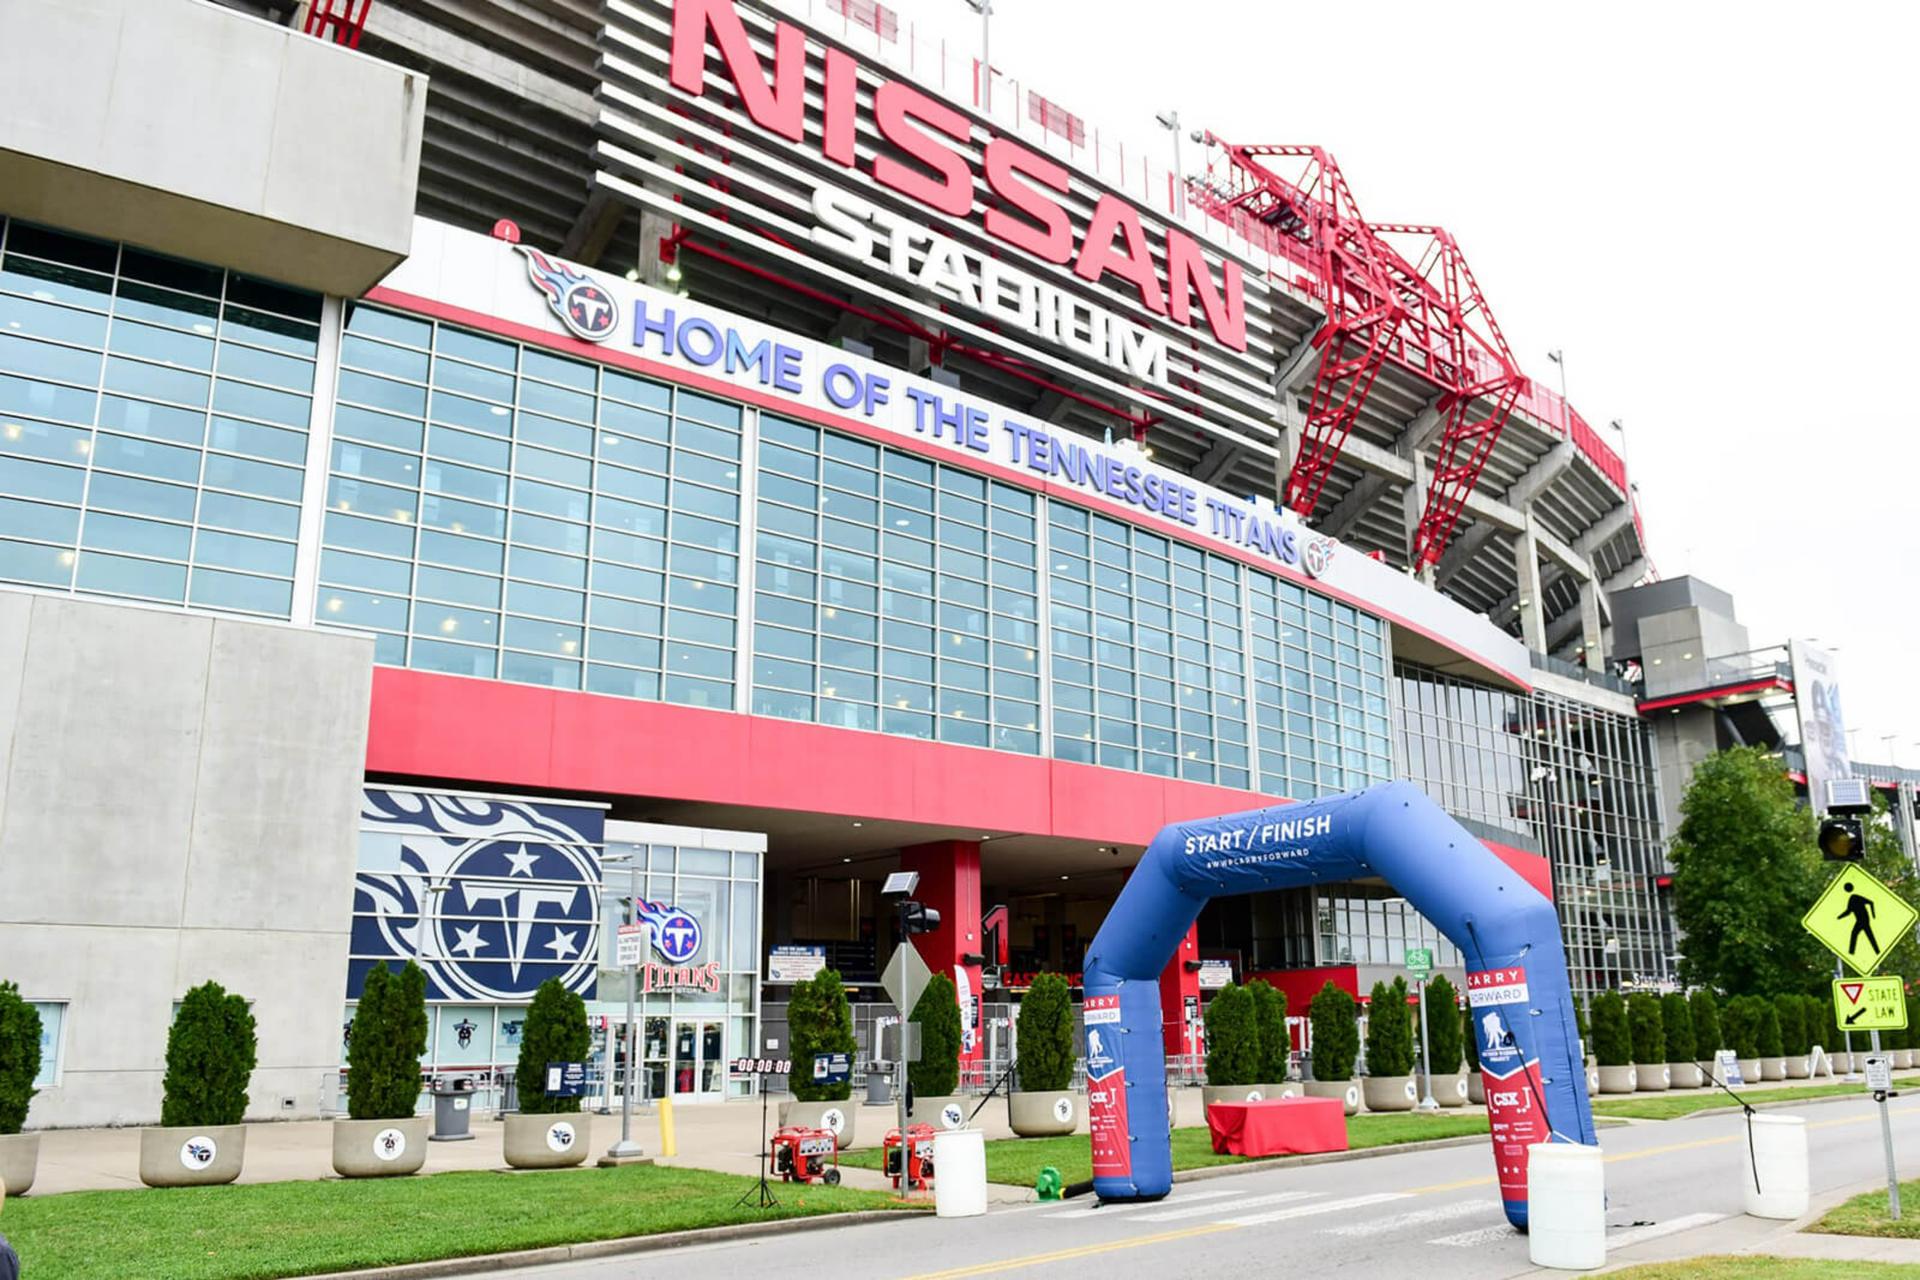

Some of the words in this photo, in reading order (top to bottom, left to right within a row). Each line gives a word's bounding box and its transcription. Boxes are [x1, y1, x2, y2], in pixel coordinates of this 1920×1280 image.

[669, 0, 1248, 354] NISSAN
[809, 184, 1169, 388] STADIUM
[633, 299, 803, 395] HOME
[823, 362, 890, 417] OF
[906, 385, 990, 454] THE
[1004, 419, 1198, 527] TENNESSEE
[1206, 496, 1299, 566] TITANS
[639, 960, 721, 993] TITANS
[1468, 970, 1518, 987] CARRY
[1084, 997, 1115, 1009] ARRY
[1868, 988, 1899, 1002] STATE
[1875, 1006, 1896, 1019] LAW
[1493, 1091, 1520, 1107] CSX
